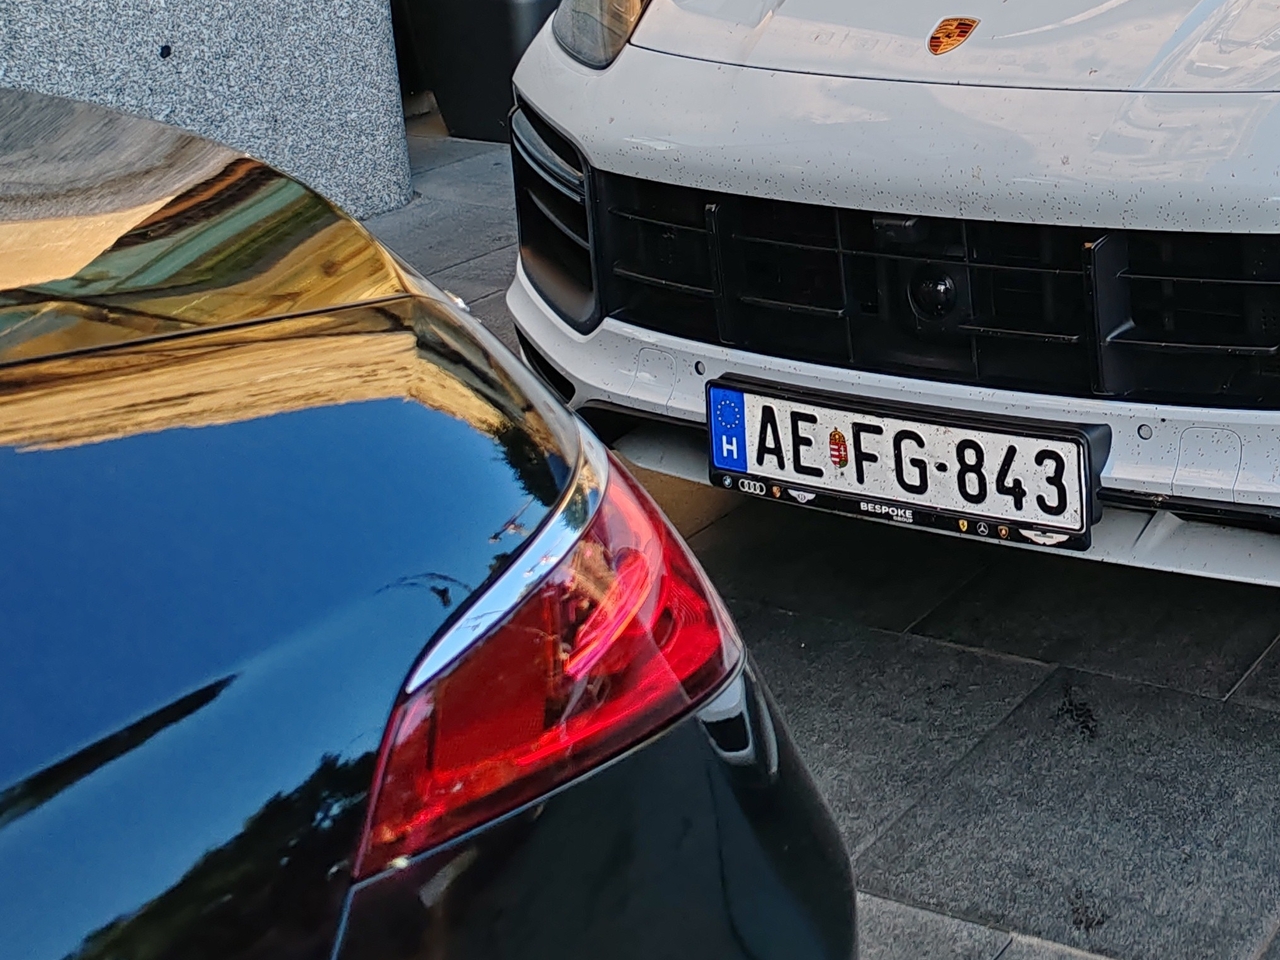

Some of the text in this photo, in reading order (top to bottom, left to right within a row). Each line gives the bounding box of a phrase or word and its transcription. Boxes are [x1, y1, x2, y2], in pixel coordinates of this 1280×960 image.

[722, 434, 739, 459] H
[852, 422, 1067, 516] FG-843
[860, 501, 913, 519] BESPOKE
[893, 515, 913, 523] GROUP
